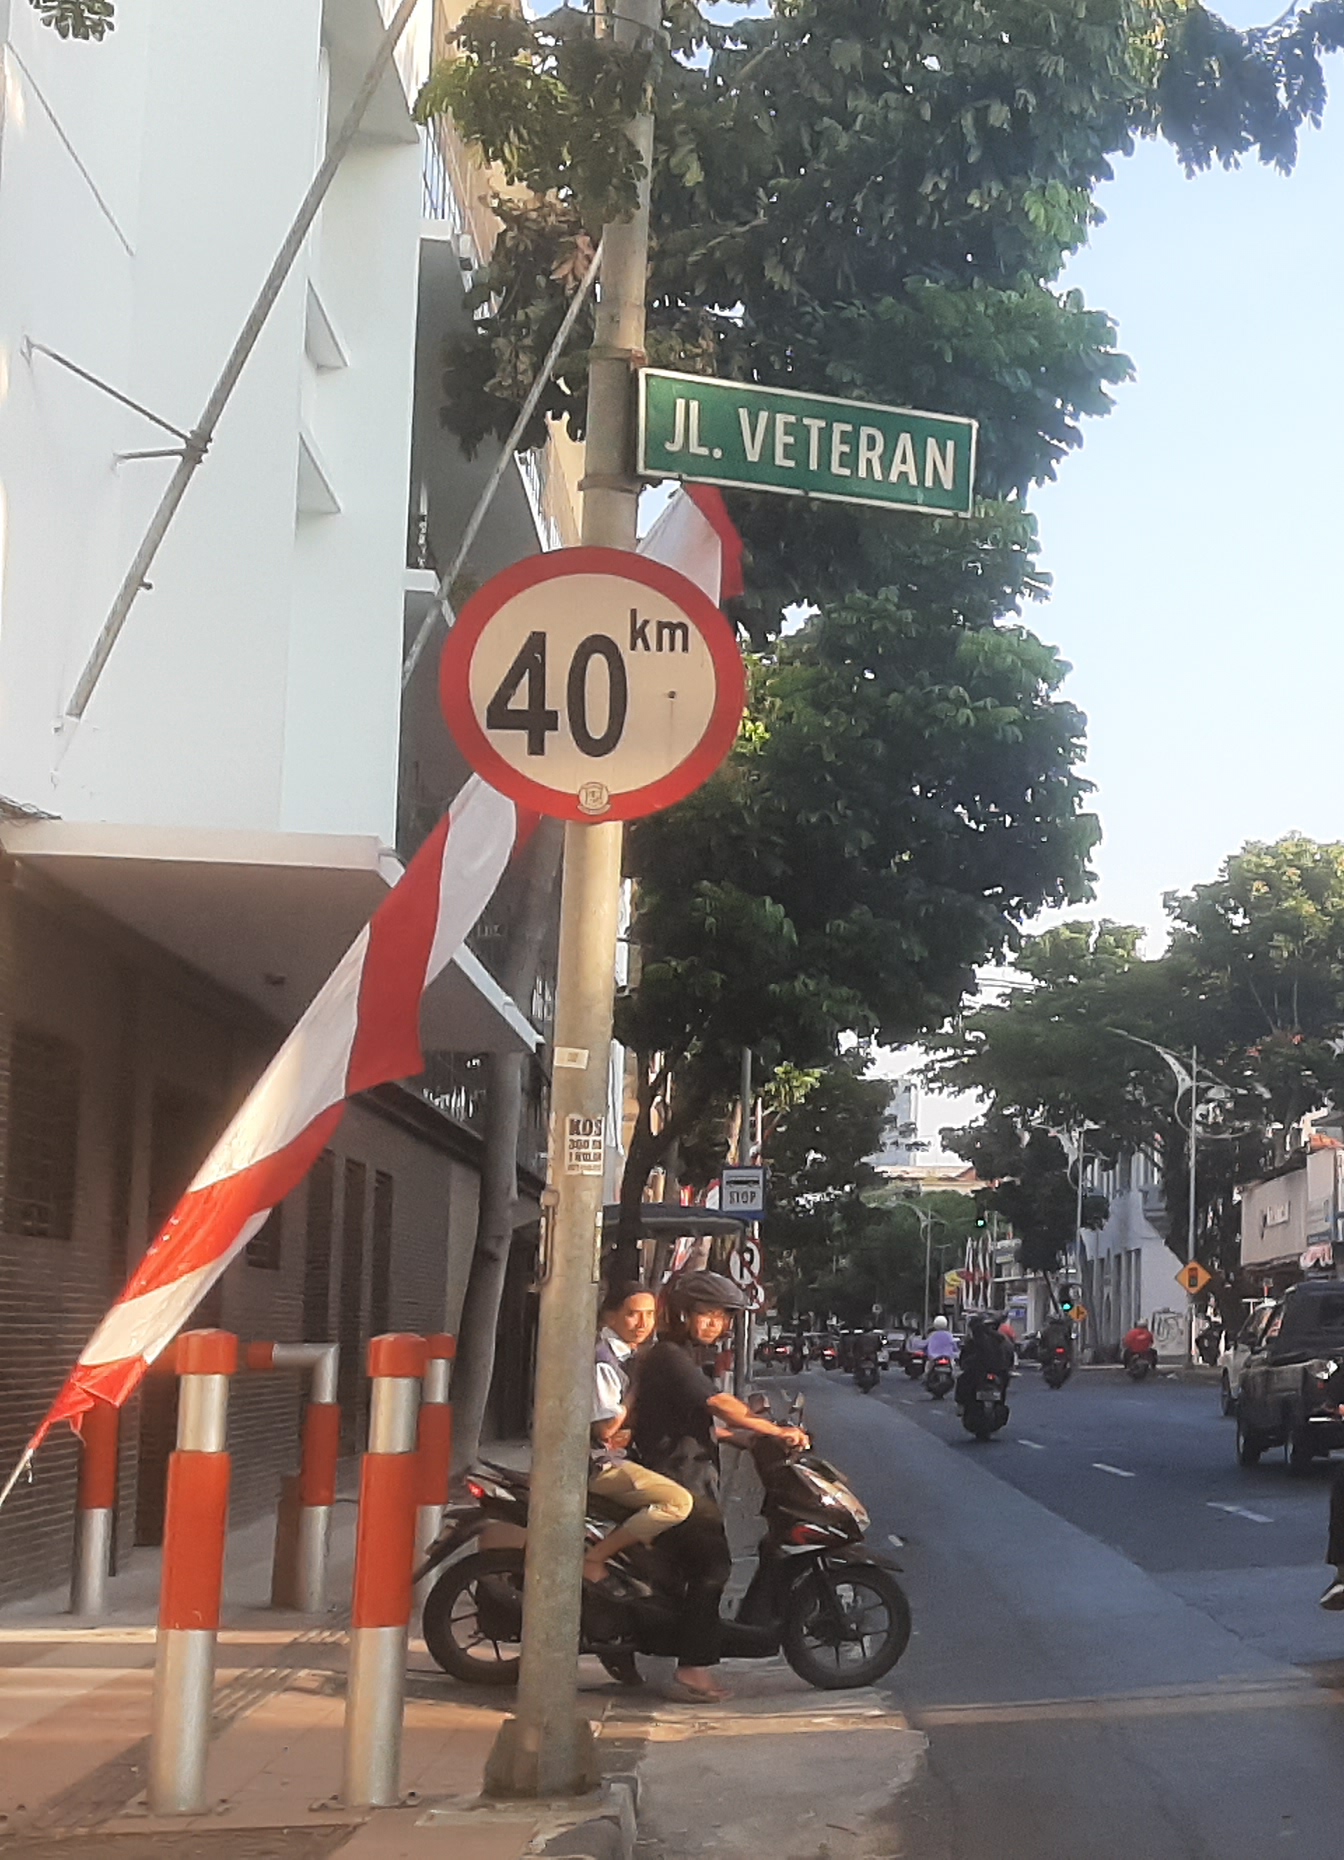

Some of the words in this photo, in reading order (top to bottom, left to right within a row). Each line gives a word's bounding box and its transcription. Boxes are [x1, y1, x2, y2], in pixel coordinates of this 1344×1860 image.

[664, 398, 723, 459] JL.
[738, 406, 956, 491] VETERAN
[629, 608, 689, 654] km
[486, 631, 628, 759] 40
[729, 1191, 757, 1205] STOP
